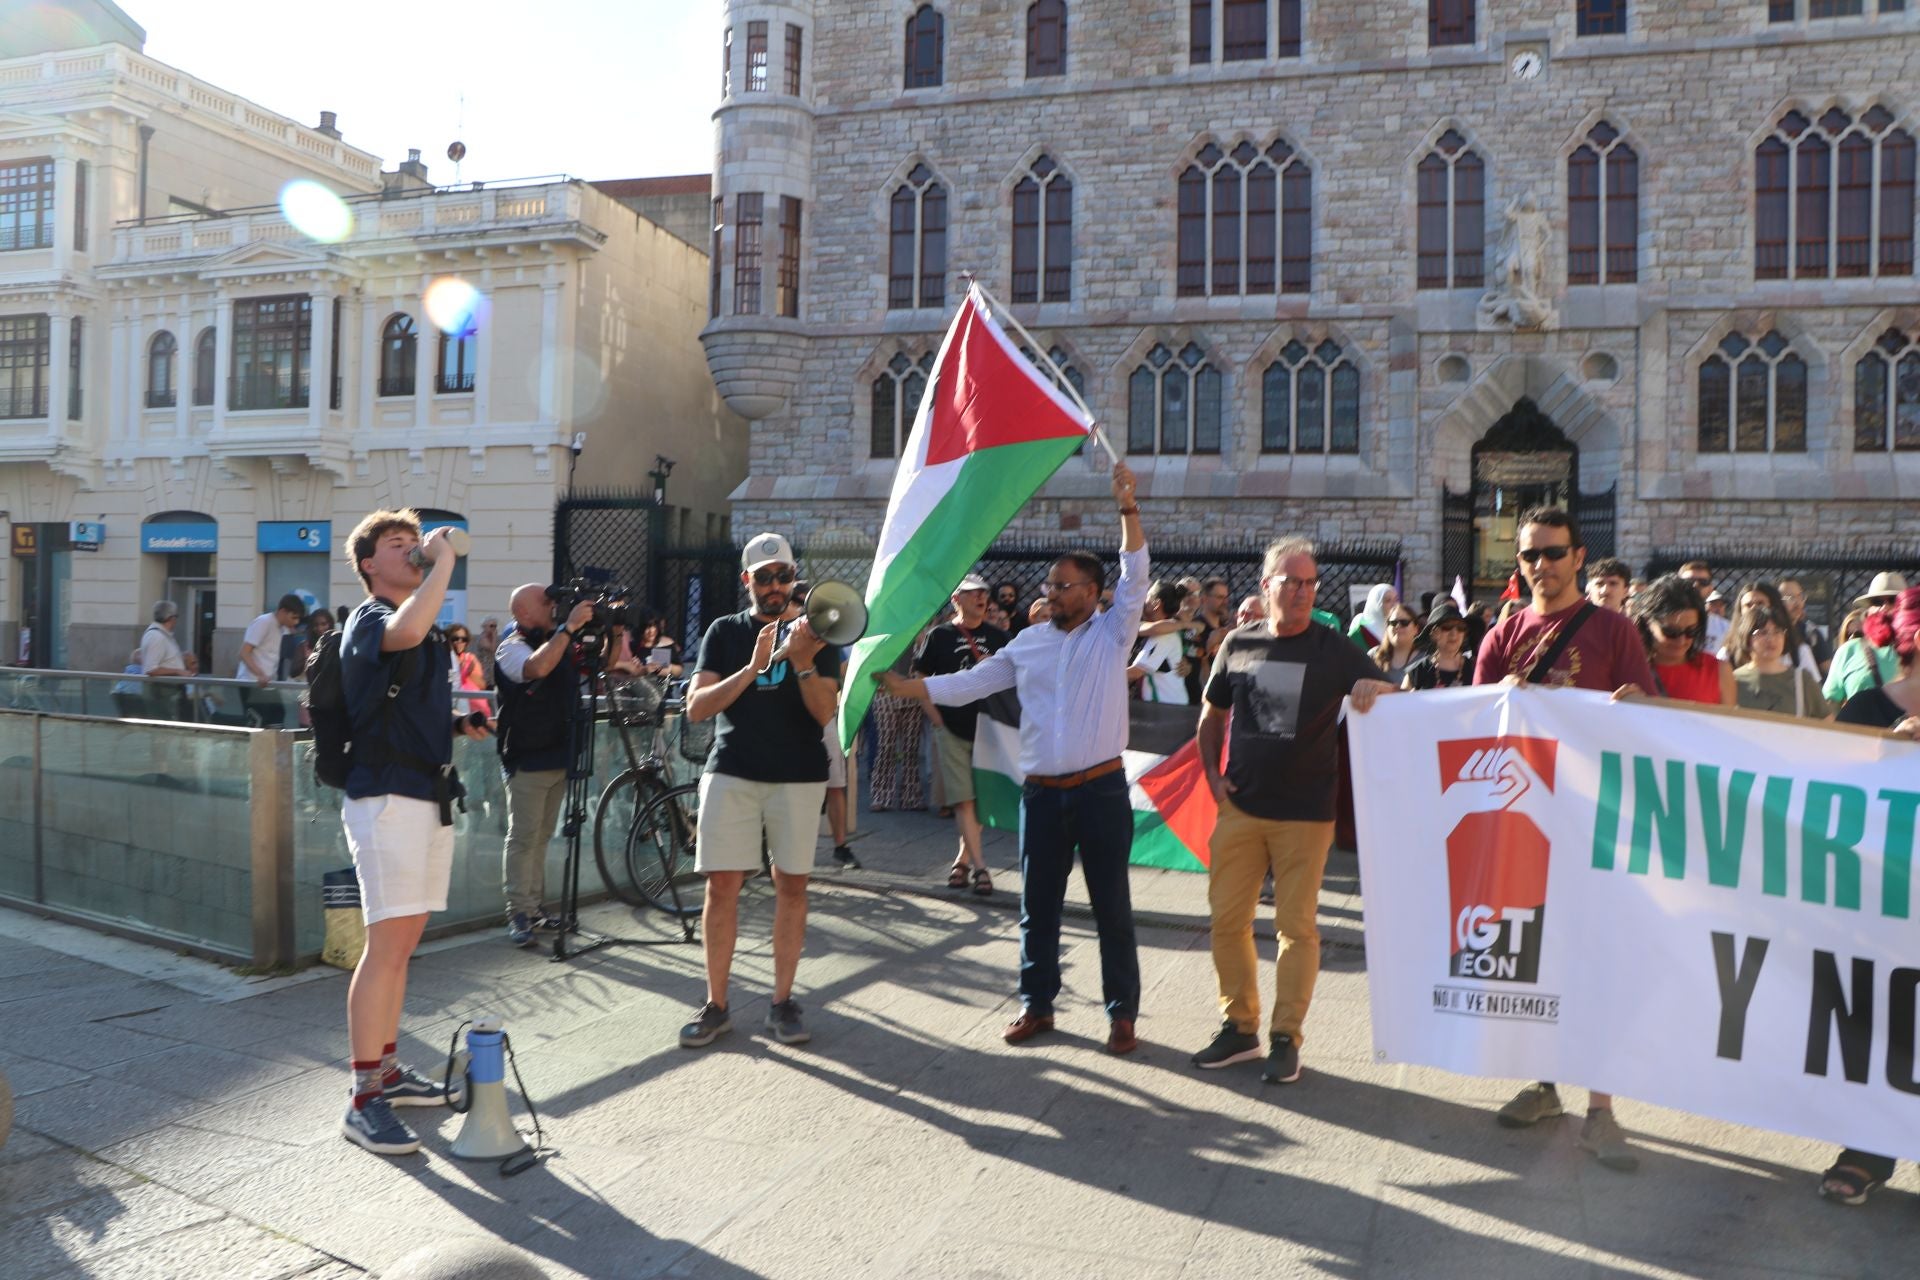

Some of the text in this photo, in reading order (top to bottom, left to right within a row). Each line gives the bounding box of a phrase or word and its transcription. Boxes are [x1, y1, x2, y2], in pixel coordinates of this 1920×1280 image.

[1591, 751, 1920, 919] INVIRT
[1466, 993, 1559, 1019] VENDEMOS
[1711, 931, 1770, 1061] Y
